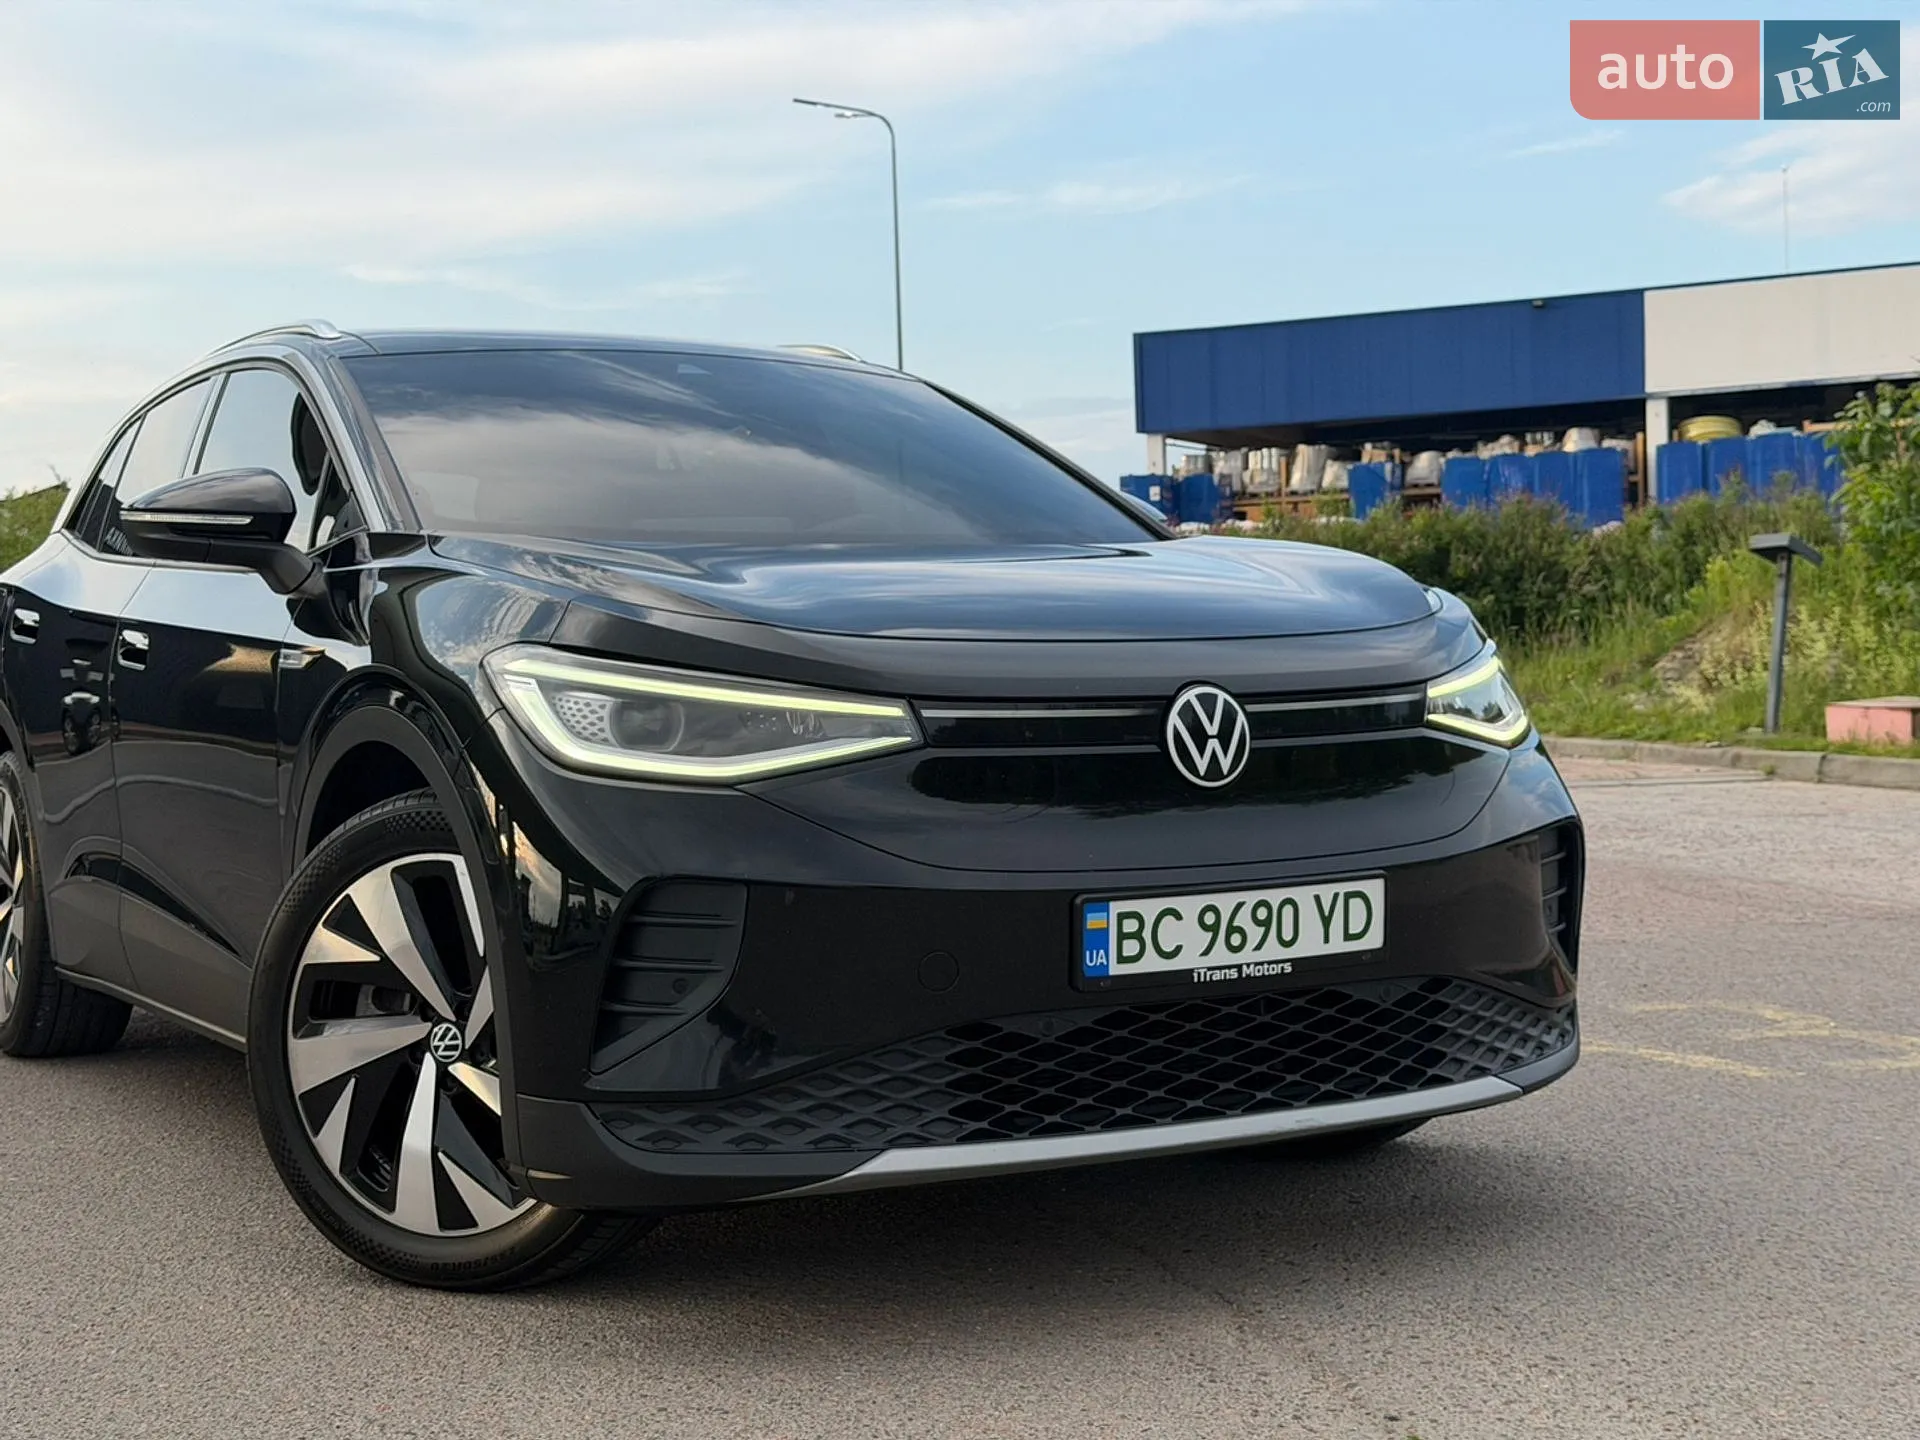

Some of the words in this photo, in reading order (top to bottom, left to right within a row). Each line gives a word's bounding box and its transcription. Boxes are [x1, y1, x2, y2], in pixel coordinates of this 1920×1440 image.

[1115, 906, 1184, 965] BC
[1197, 897, 1299, 956] 9690
[1313, 890, 1373, 944] YD
[1086, 950, 1107, 966] UA
[1192, 967, 1238, 982] iTrans
[1242, 962, 1293, 978] Motors
